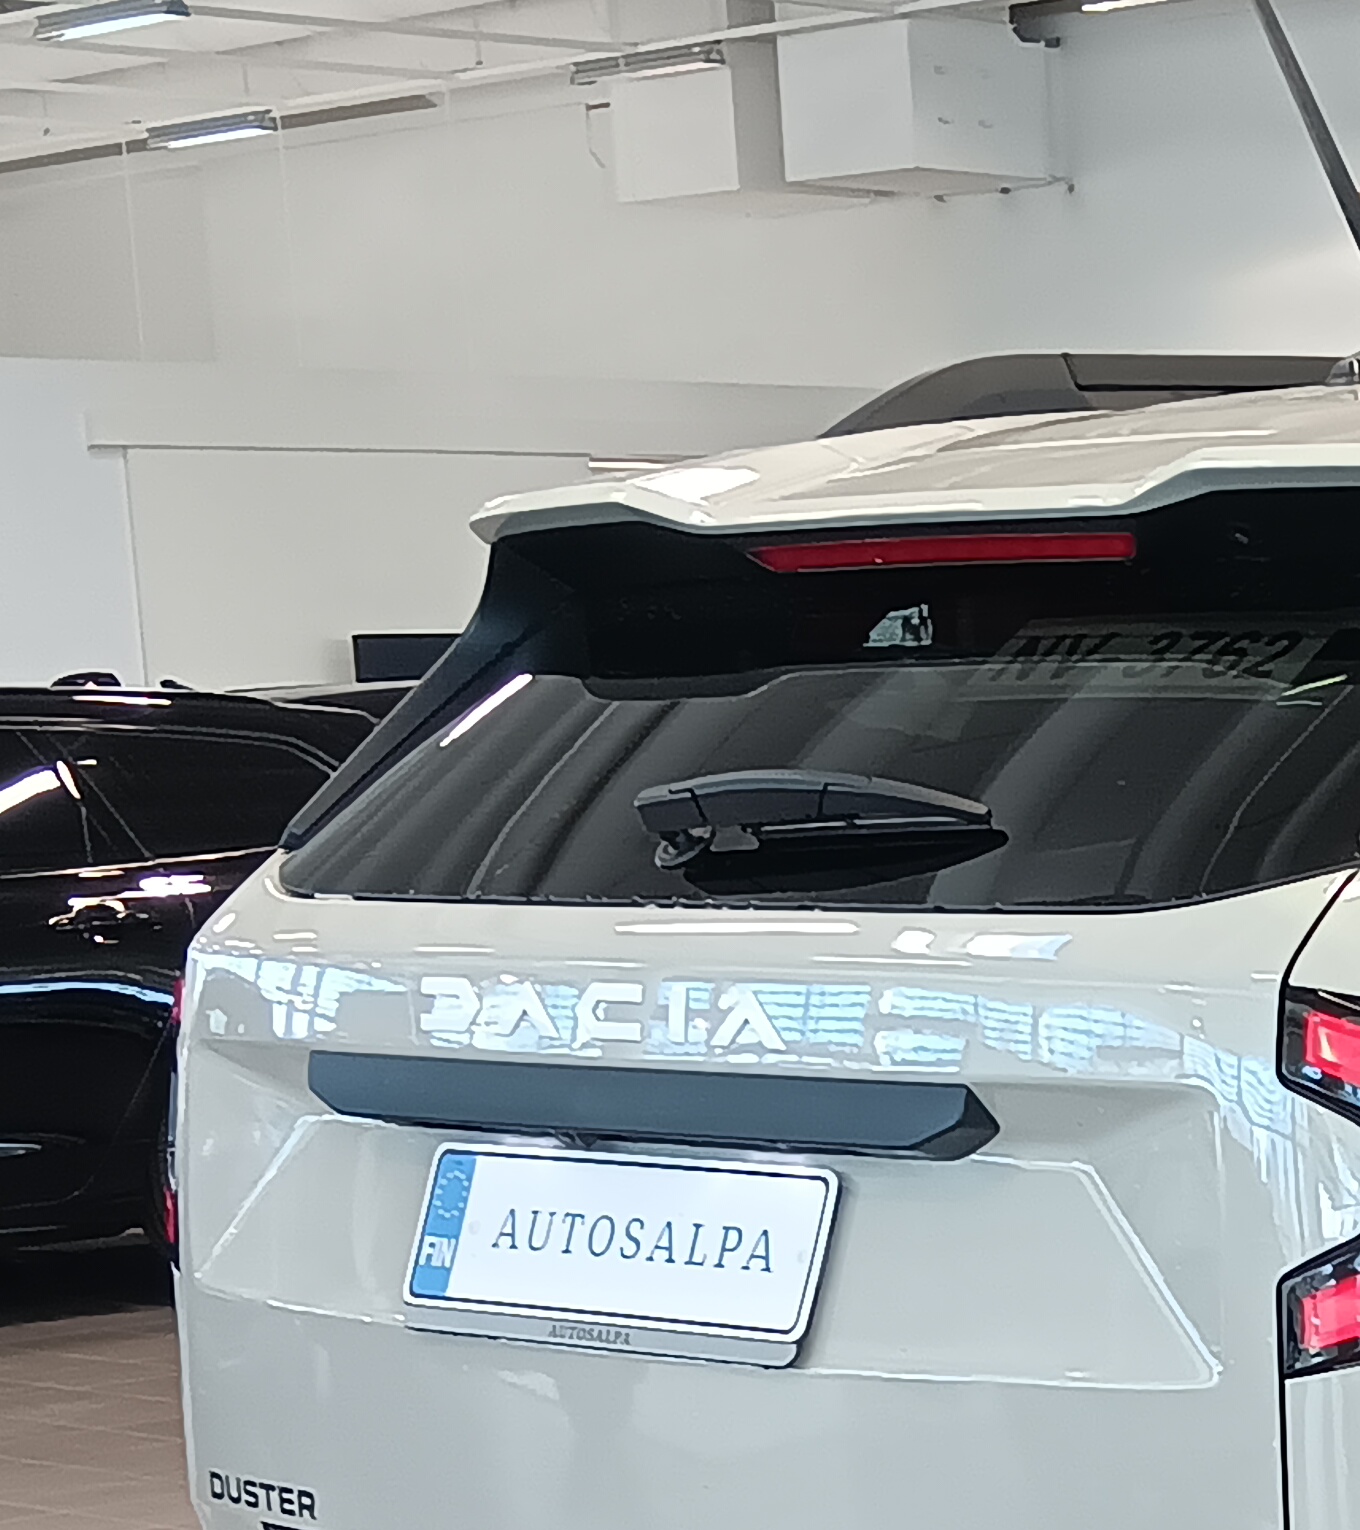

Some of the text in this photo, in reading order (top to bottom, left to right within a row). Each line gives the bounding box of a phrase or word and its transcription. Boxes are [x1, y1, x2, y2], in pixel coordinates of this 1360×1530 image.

[419, 976, 787, 1052] DACIA
[418, 1234, 457, 1268] FIN
[491, 1208, 774, 1274] AUTOSALPA
[547, 1324, 632, 1346] AUTOSALPA
[208, 1470, 317, 1520] DUSTER
